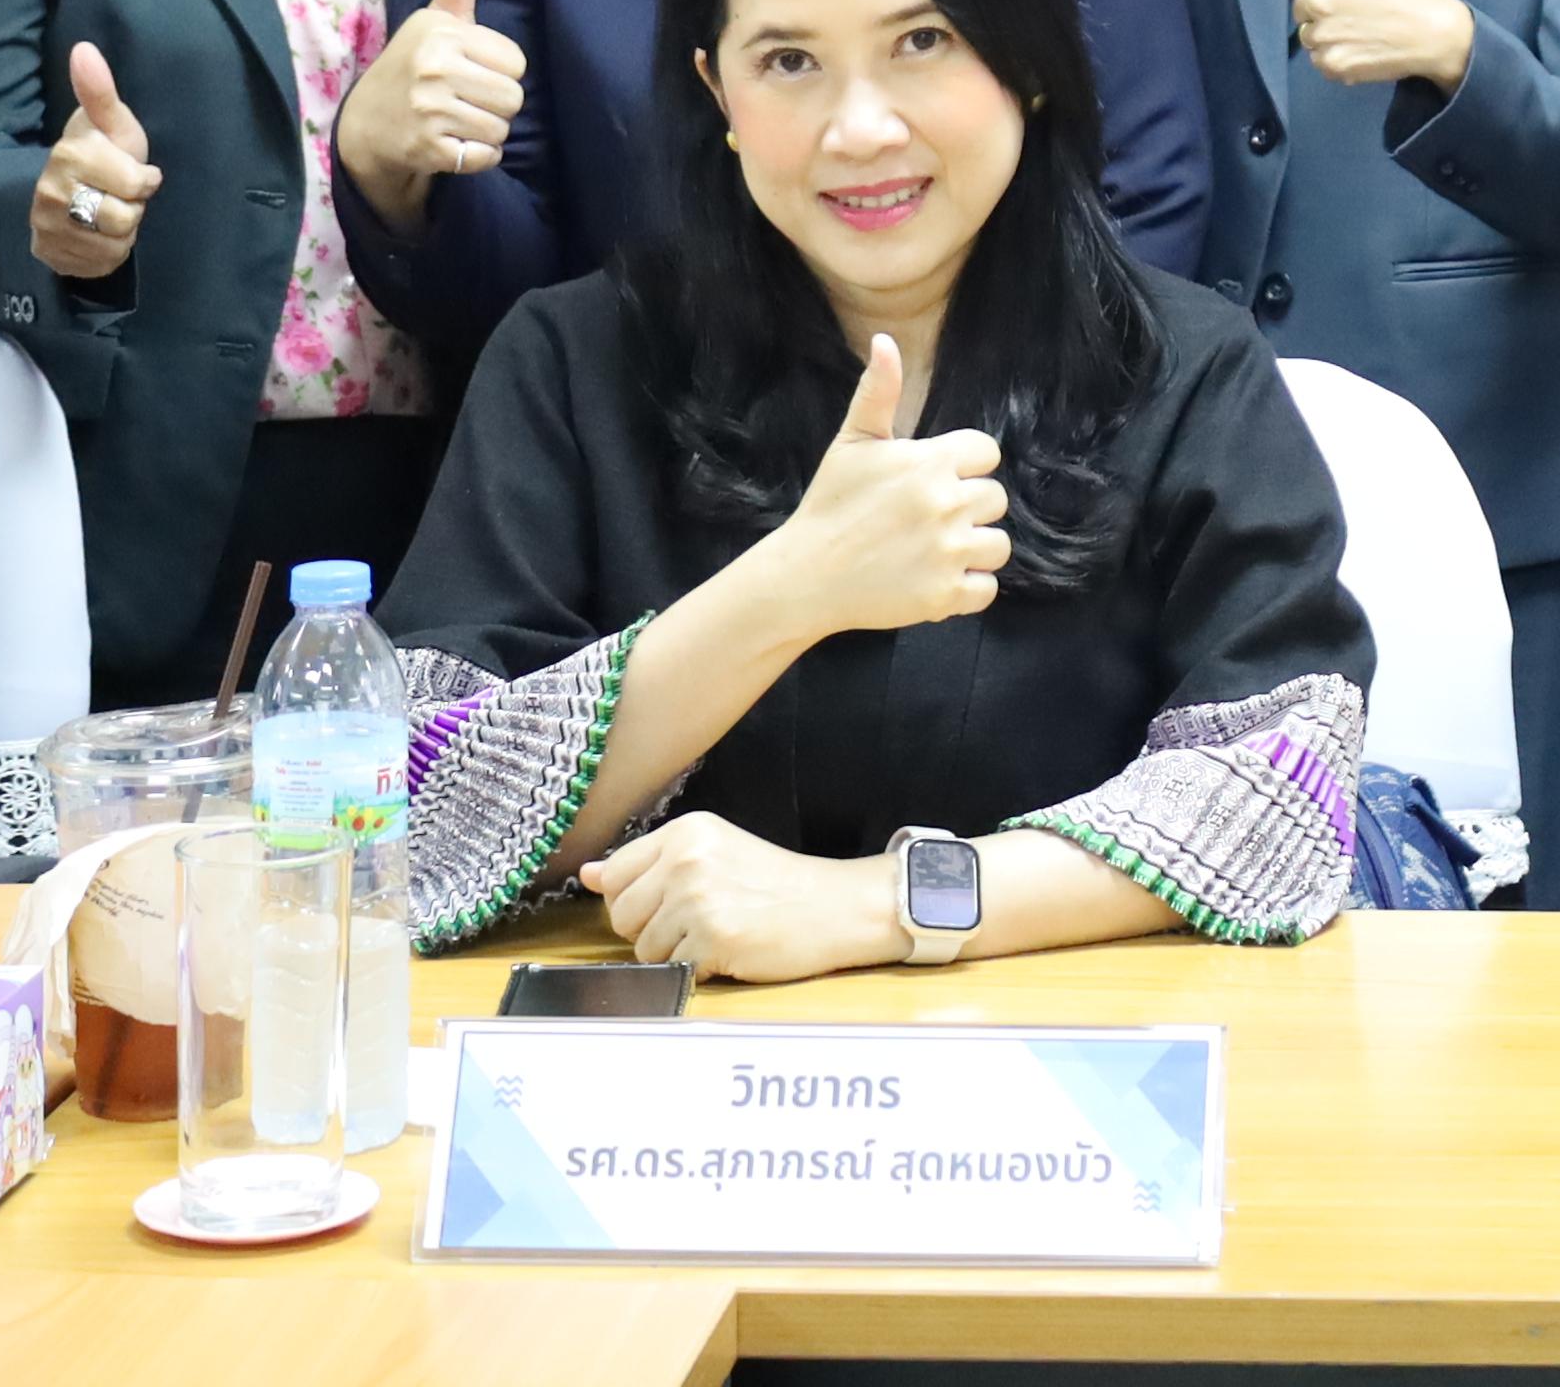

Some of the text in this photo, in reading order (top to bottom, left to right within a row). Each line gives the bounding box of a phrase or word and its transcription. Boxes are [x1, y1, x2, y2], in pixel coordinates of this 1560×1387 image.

[730, 1064, 902, 1109] วิทยากร
[565, 1139, 1113, 1194] รศ.ดร.สุภาภรณ์ สุดหนองบัว
